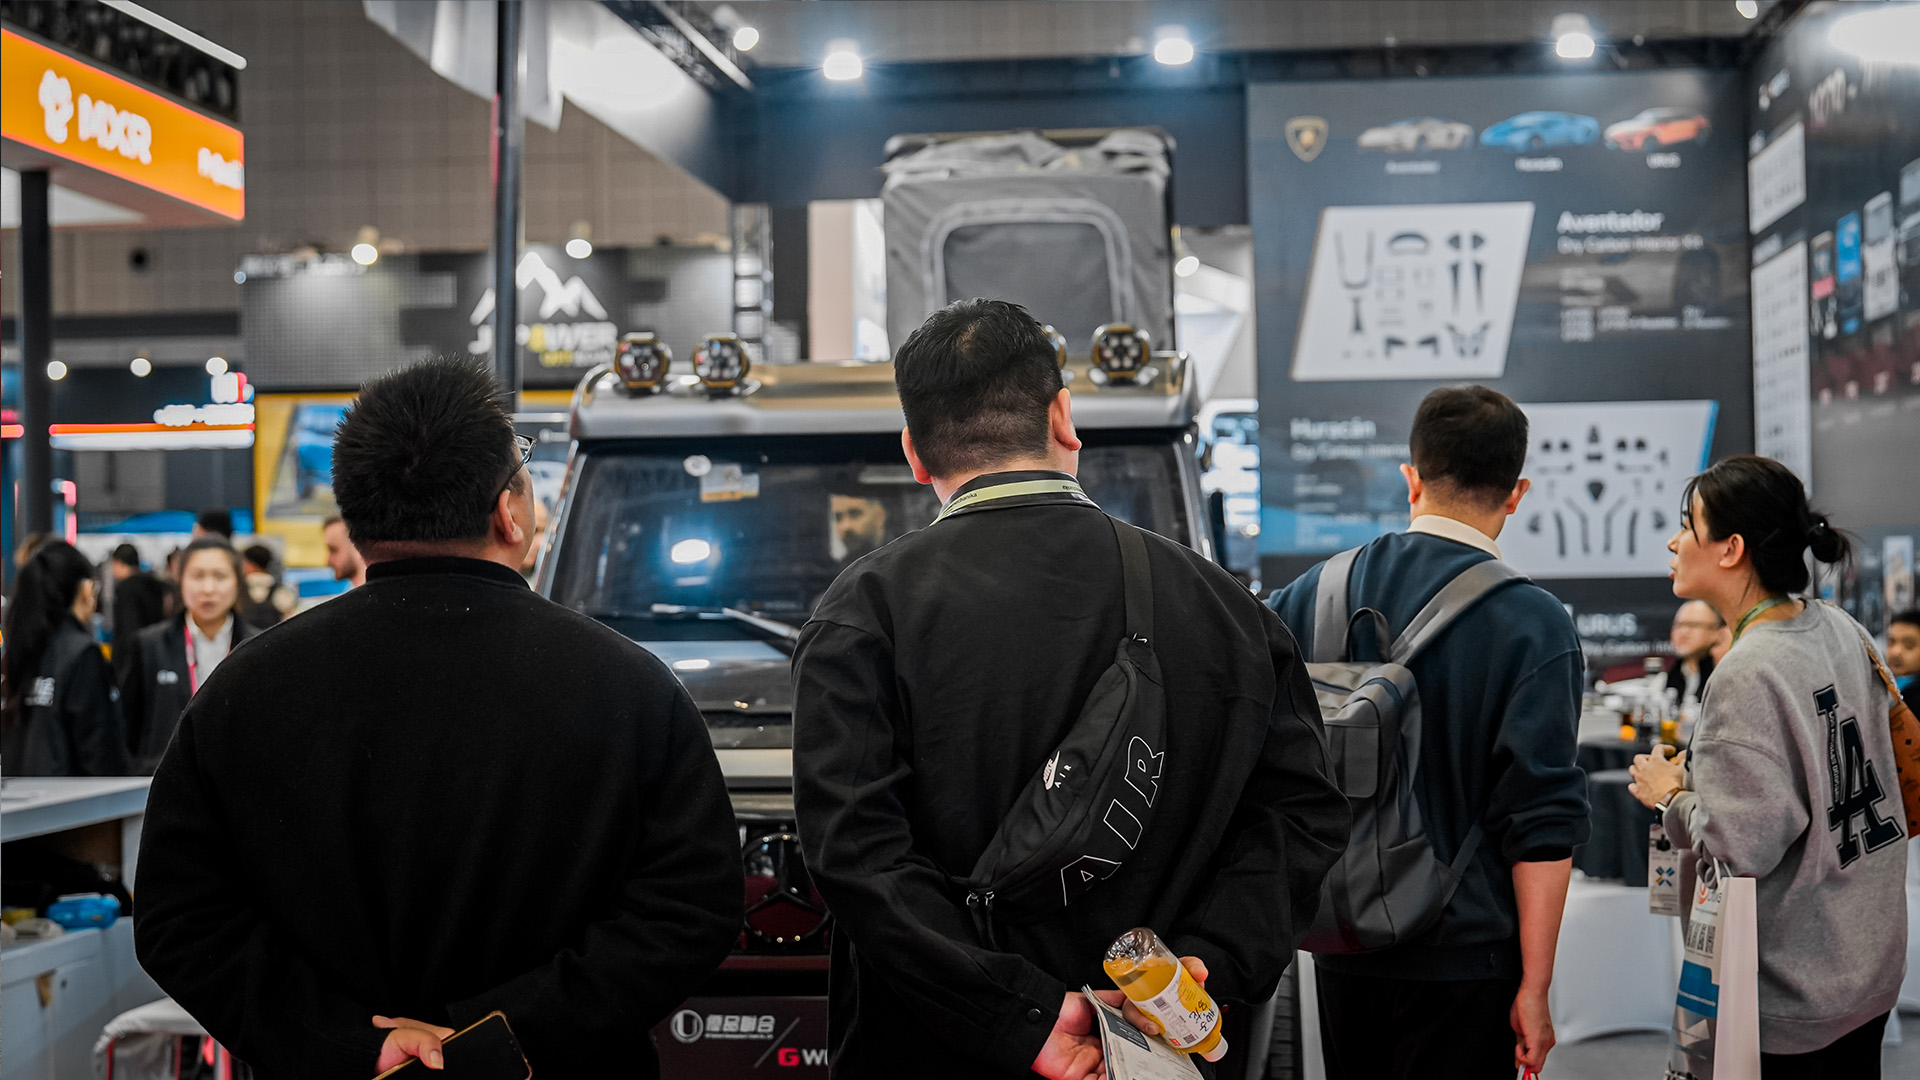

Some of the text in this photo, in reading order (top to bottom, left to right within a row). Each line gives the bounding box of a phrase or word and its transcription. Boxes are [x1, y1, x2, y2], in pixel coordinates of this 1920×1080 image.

[1556, 210, 1665, 234] Aventador
[1290, 416, 1377, 440] Huracán
[1577, 612, 1637, 637] URUS
[1054, 764, 1072, 788] AIR
[1060, 736, 1165, 907] AIR
